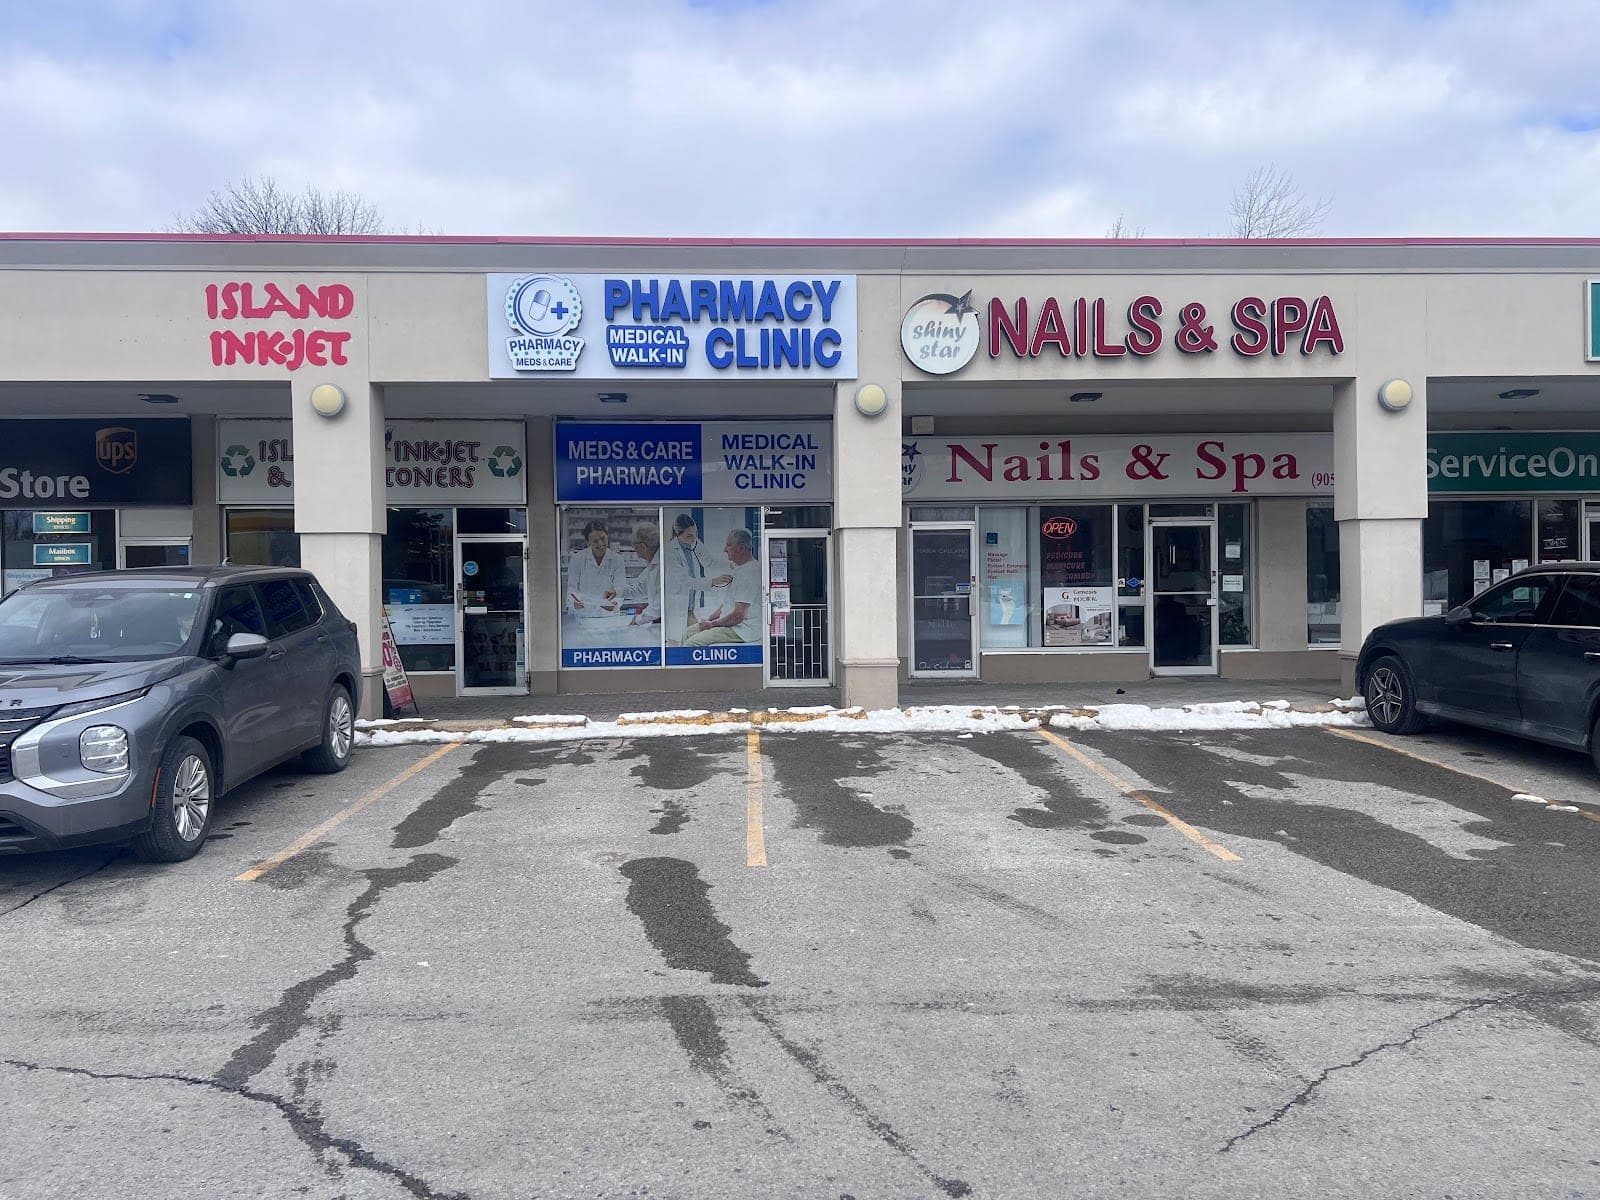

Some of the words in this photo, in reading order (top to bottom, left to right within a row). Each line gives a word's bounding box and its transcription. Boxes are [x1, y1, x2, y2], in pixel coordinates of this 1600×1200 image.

[205, 282, 354, 320] ISLAND
[604, 279, 842, 322] PHARMACY
[609, 328, 686, 345] MEDICAL
[912, 320, 967, 343] shiny
[988, 295, 1163, 359] NAILS
[1175, 302, 1218, 354] &
[1231, 295, 1344, 357] SPA
[509, 338, 580, 352] PHARMACY
[705, 327, 842, 369] CLINIC
[920, 340, 960, 359] star
[516, 358, 541, 366] MEDS
[549, 358, 572, 366] CARE
[612, 347, 684, 364] WALK-IN
[259, 439, 294, 462] ISL
[568, 441, 623, 460] MEDS
[641, 441, 693, 460] CARE
[722, 434, 818, 450] MEDICAL
[100, 441, 134, 468] ups
[724, 454, 815, 470] WALK-IN
[576, 466, 686, 485] PHARMACY
[946, 440, 1100, 483] Nails
[1125, 444, 1171, 480] &
[1196, 441, 1300, 492] Spa
[0, 467, 90, 499] Store
[267, 466, 292, 487] &
[735, 473, 806, 489] CLINIC
[1044, 522, 1074, 534] OPEN
[573, 649, 652, 663] PHARMACY
[692, 648, 738, 662] CLINIC
